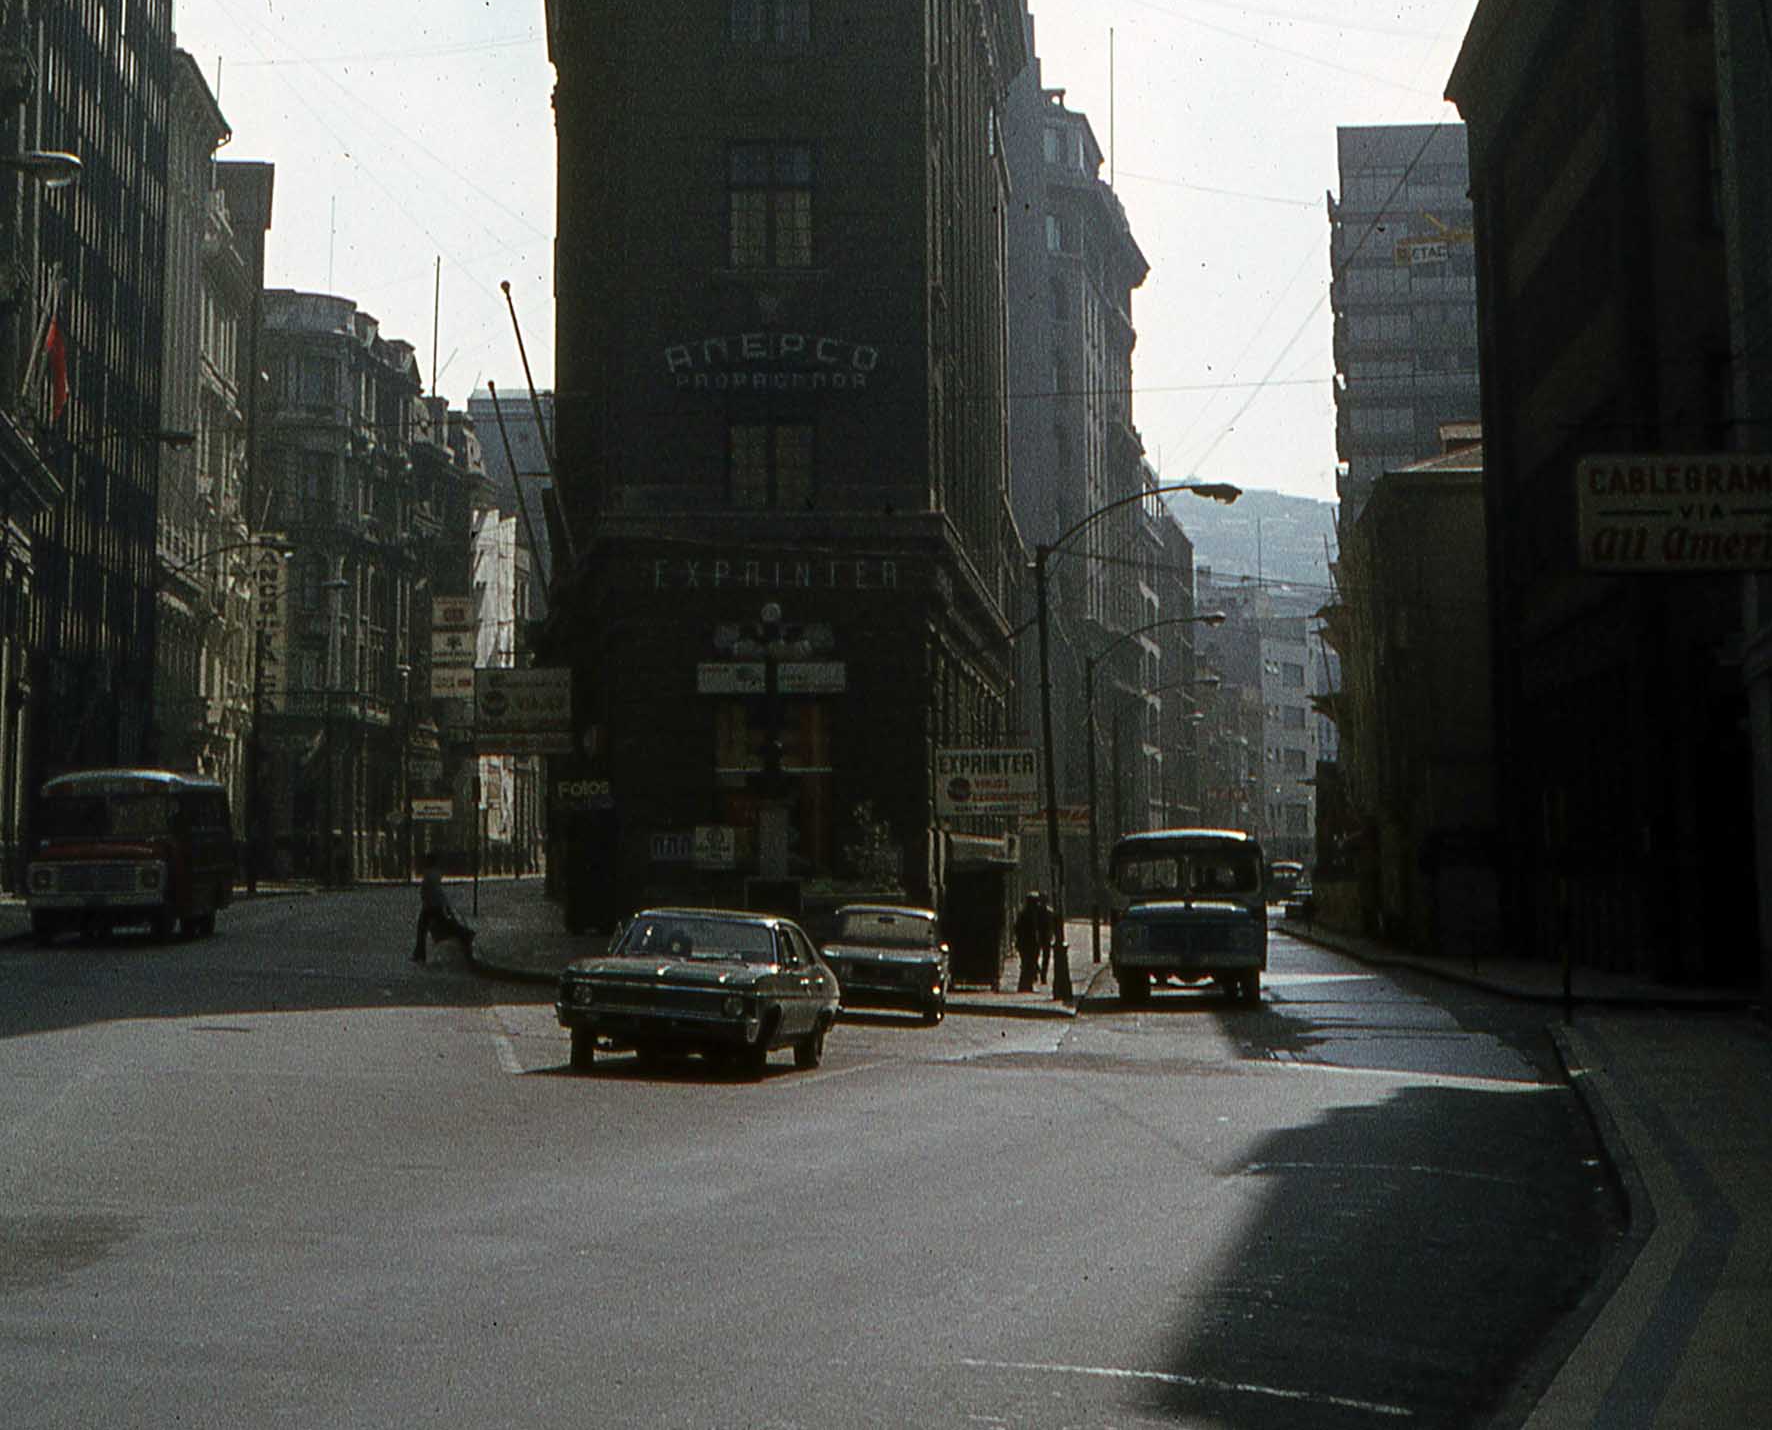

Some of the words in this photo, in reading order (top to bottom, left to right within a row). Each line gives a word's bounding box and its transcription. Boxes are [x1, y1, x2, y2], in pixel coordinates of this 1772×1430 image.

[1680, 504, 1724, 520] VIA
[655, 560, 898, 588] EXPRINTER
[939, 753, 1036, 775] EXPRINTER
